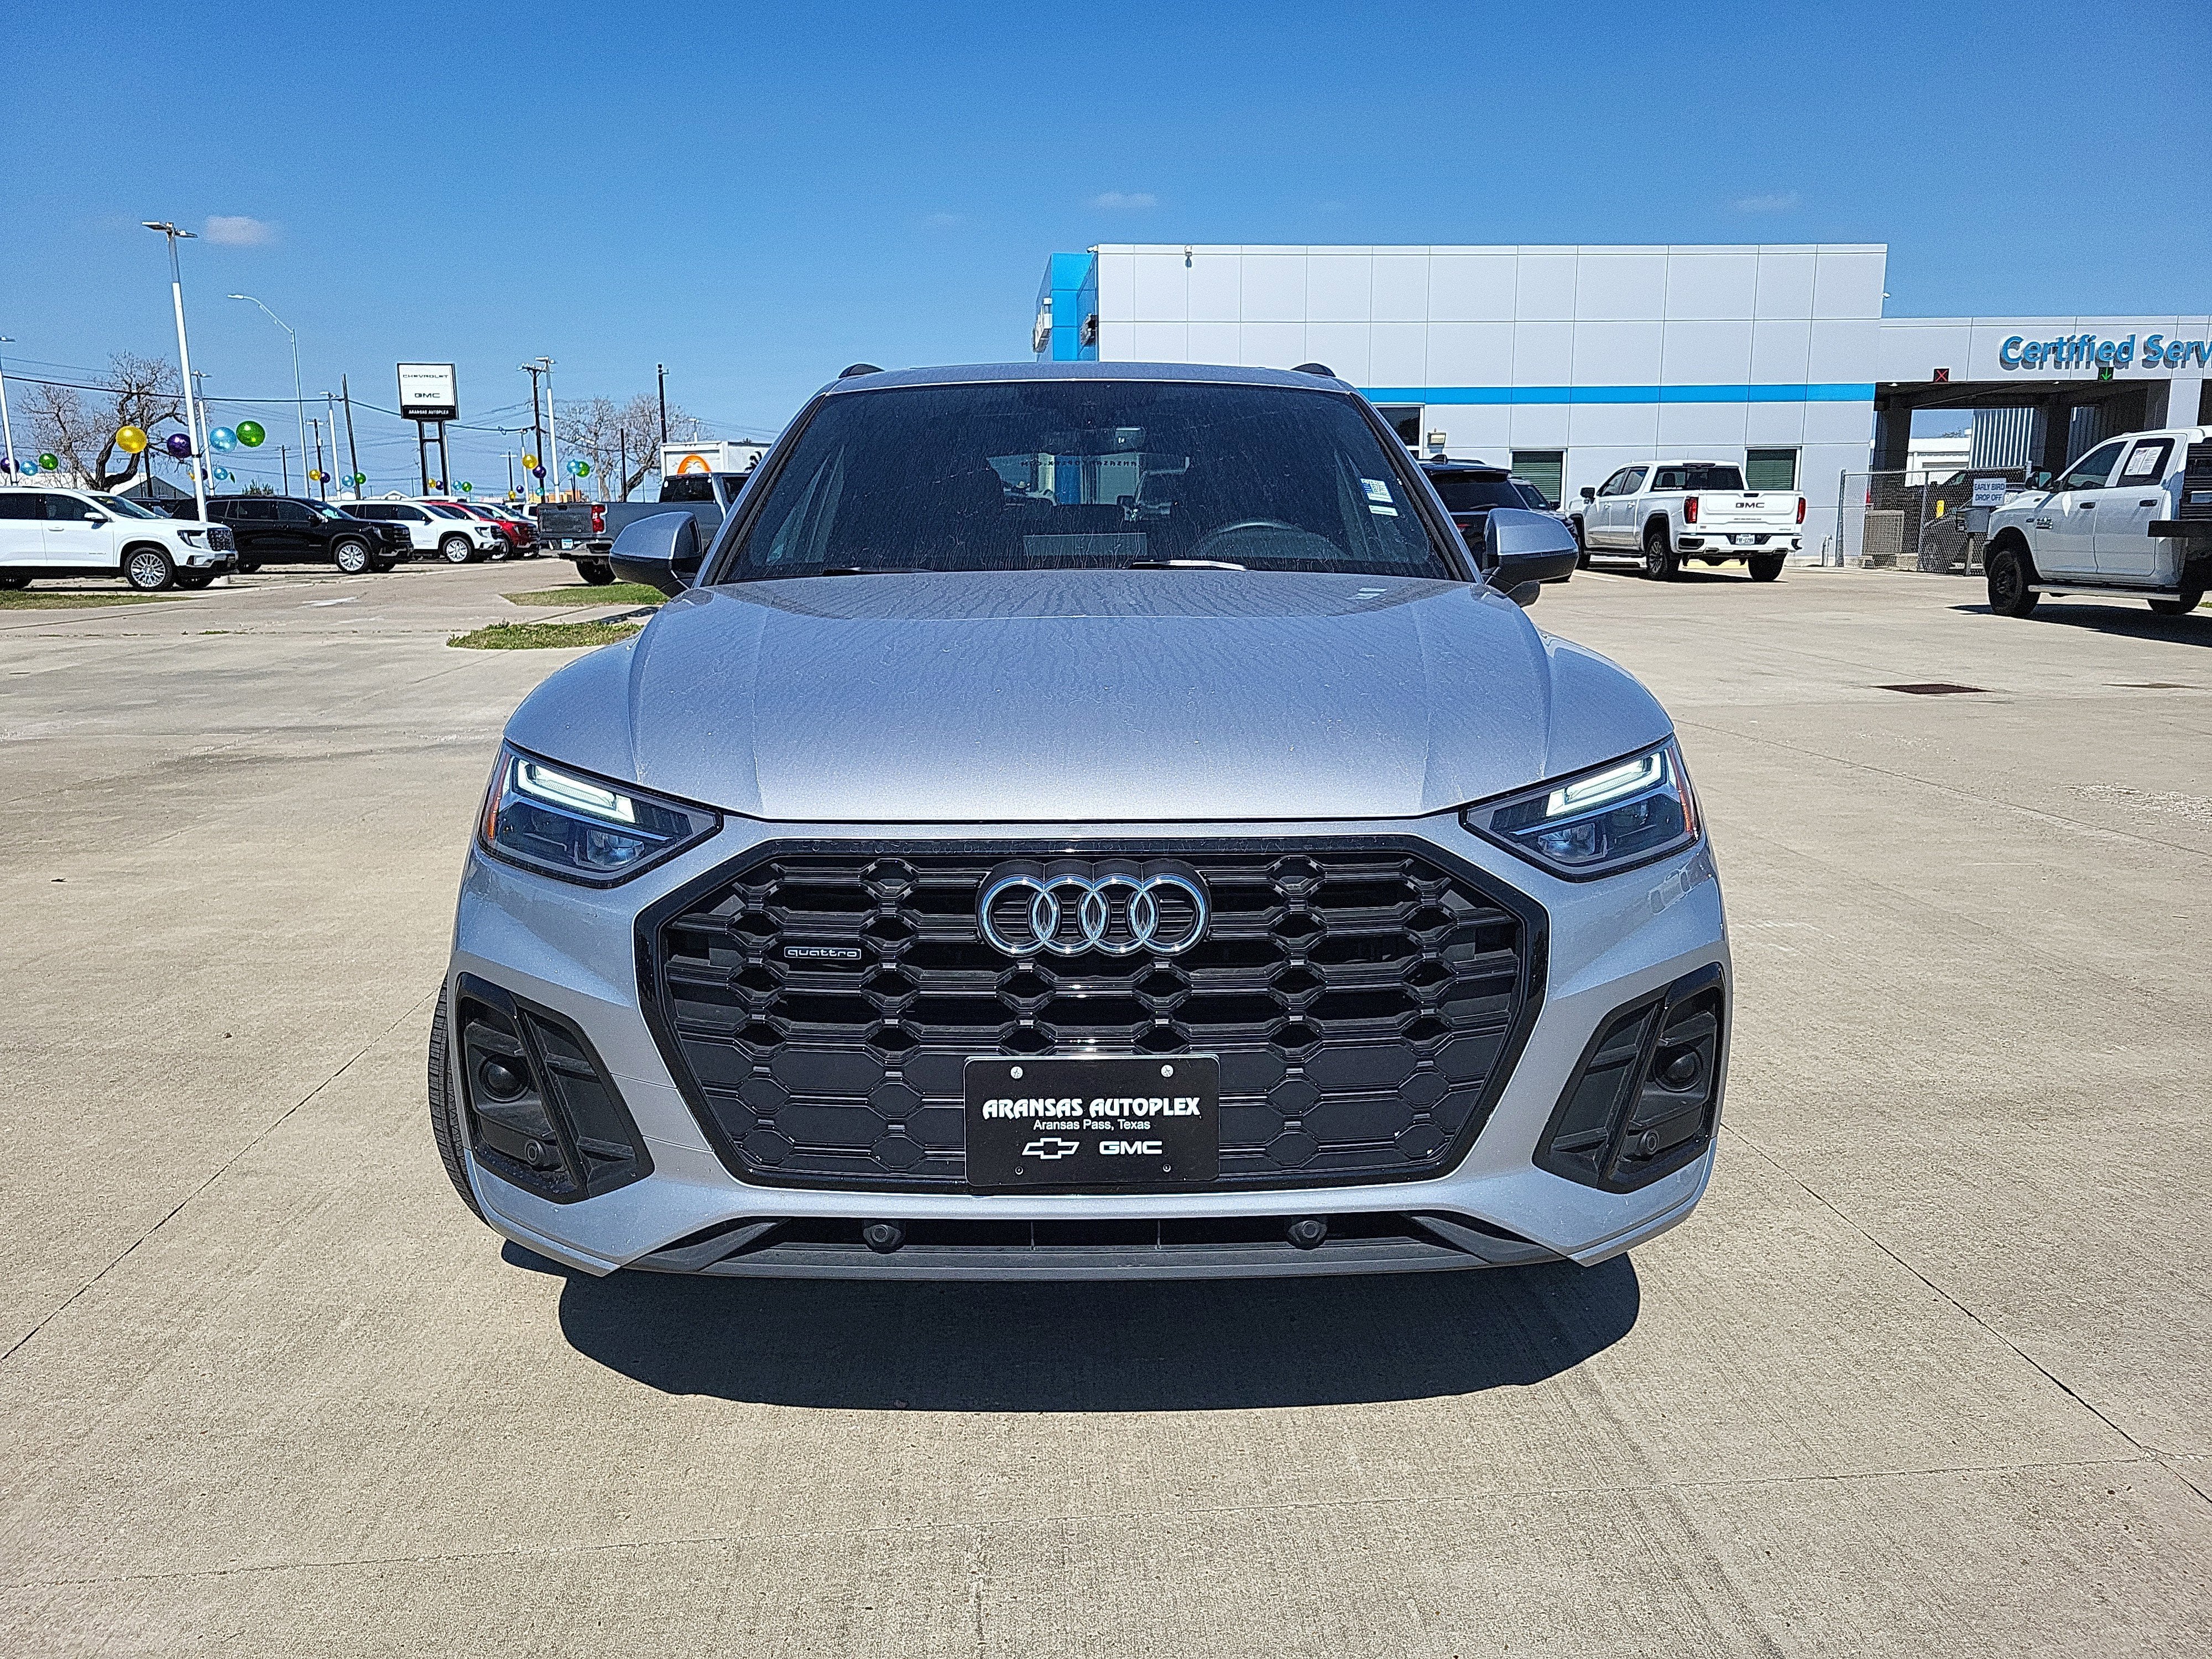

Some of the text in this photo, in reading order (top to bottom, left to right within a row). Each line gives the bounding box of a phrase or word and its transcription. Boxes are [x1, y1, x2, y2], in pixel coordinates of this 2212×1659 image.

[2001, 334, 2136, 363] Certified
[1974, 483, 1991, 491] EARLY
[1992, 493, 2003, 502] OFF
[787, 949, 857, 957] quattro
[982, 1097, 1201, 1120] ARANSAS AUTOPLEX
[1033, 1119, 1151, 1131] Aransas Pass, Texas
[1099, 1141, 1162, 1155] GMC
